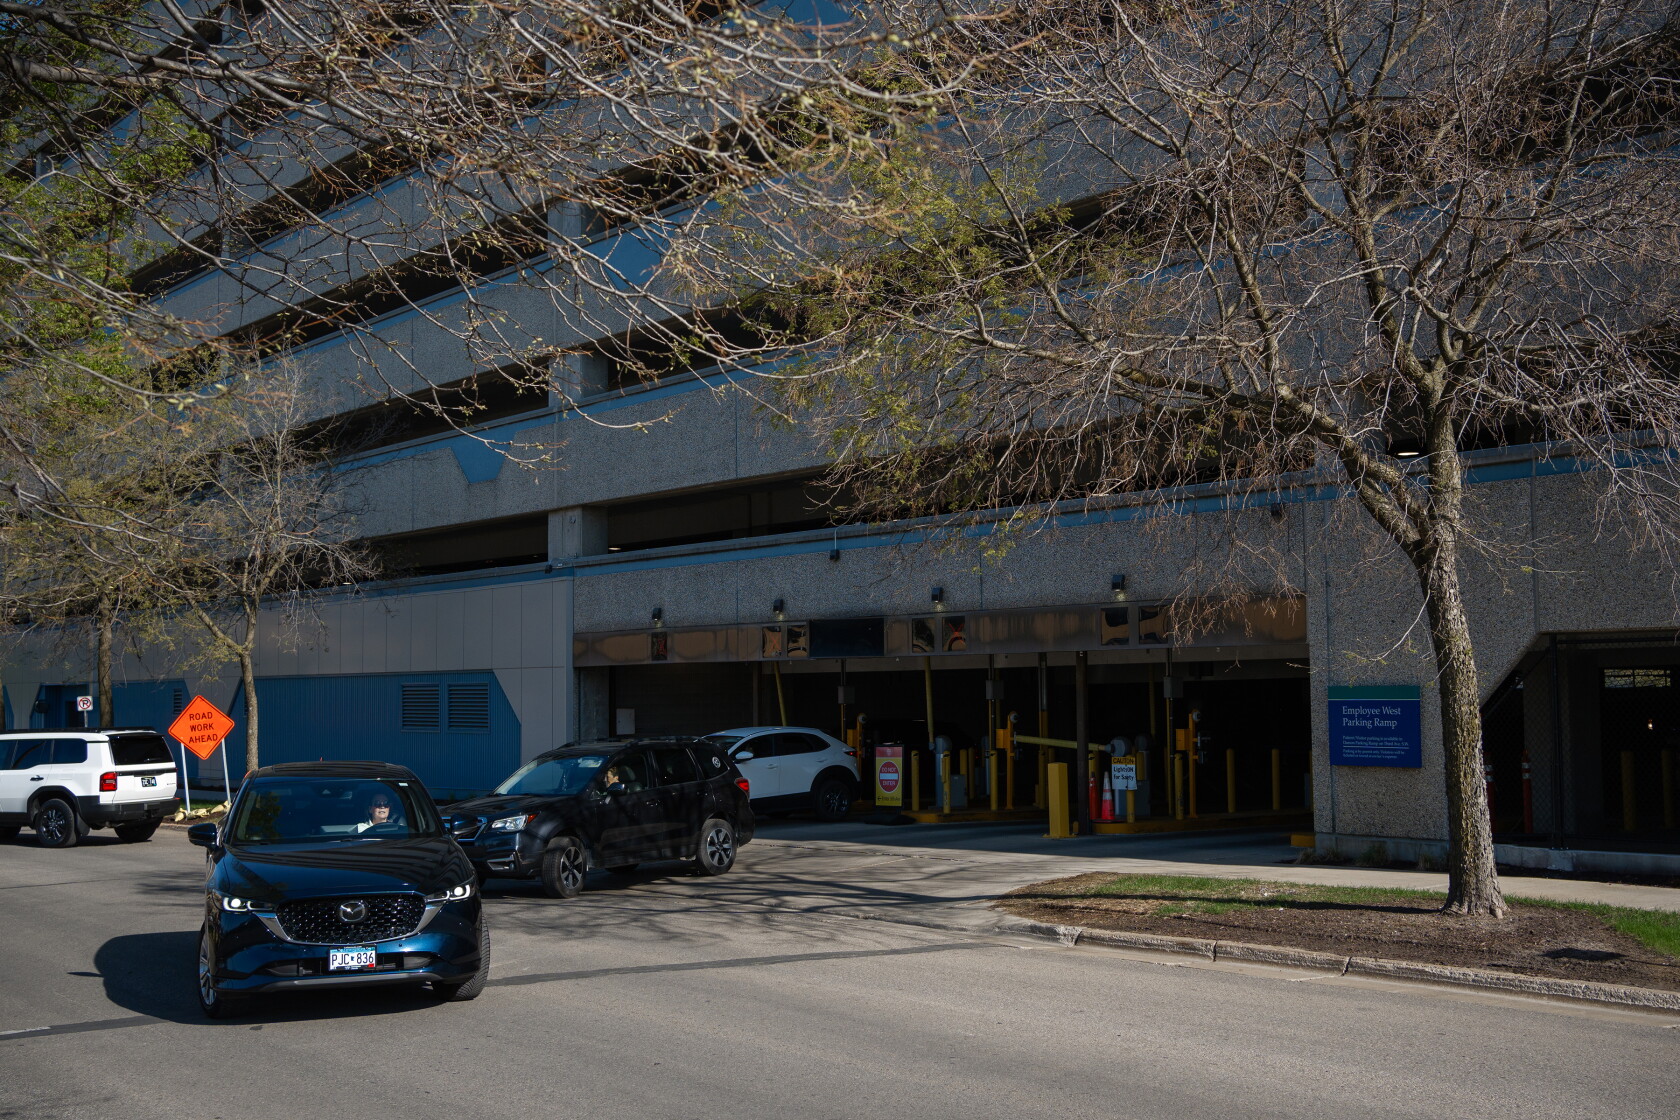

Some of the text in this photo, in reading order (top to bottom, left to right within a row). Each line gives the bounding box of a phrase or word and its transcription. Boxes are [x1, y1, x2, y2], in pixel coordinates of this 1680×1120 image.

[189, 711, 213, 721] ROAD
[1342, 706, 1401, 717] Employee West
[190, 722, 214, 732] WORK
[1342, 717, 1397, 729] Parking Ramp
[189, 733, 218, 744] AHEAD
[331, 952, 374, 966] PJC 836
